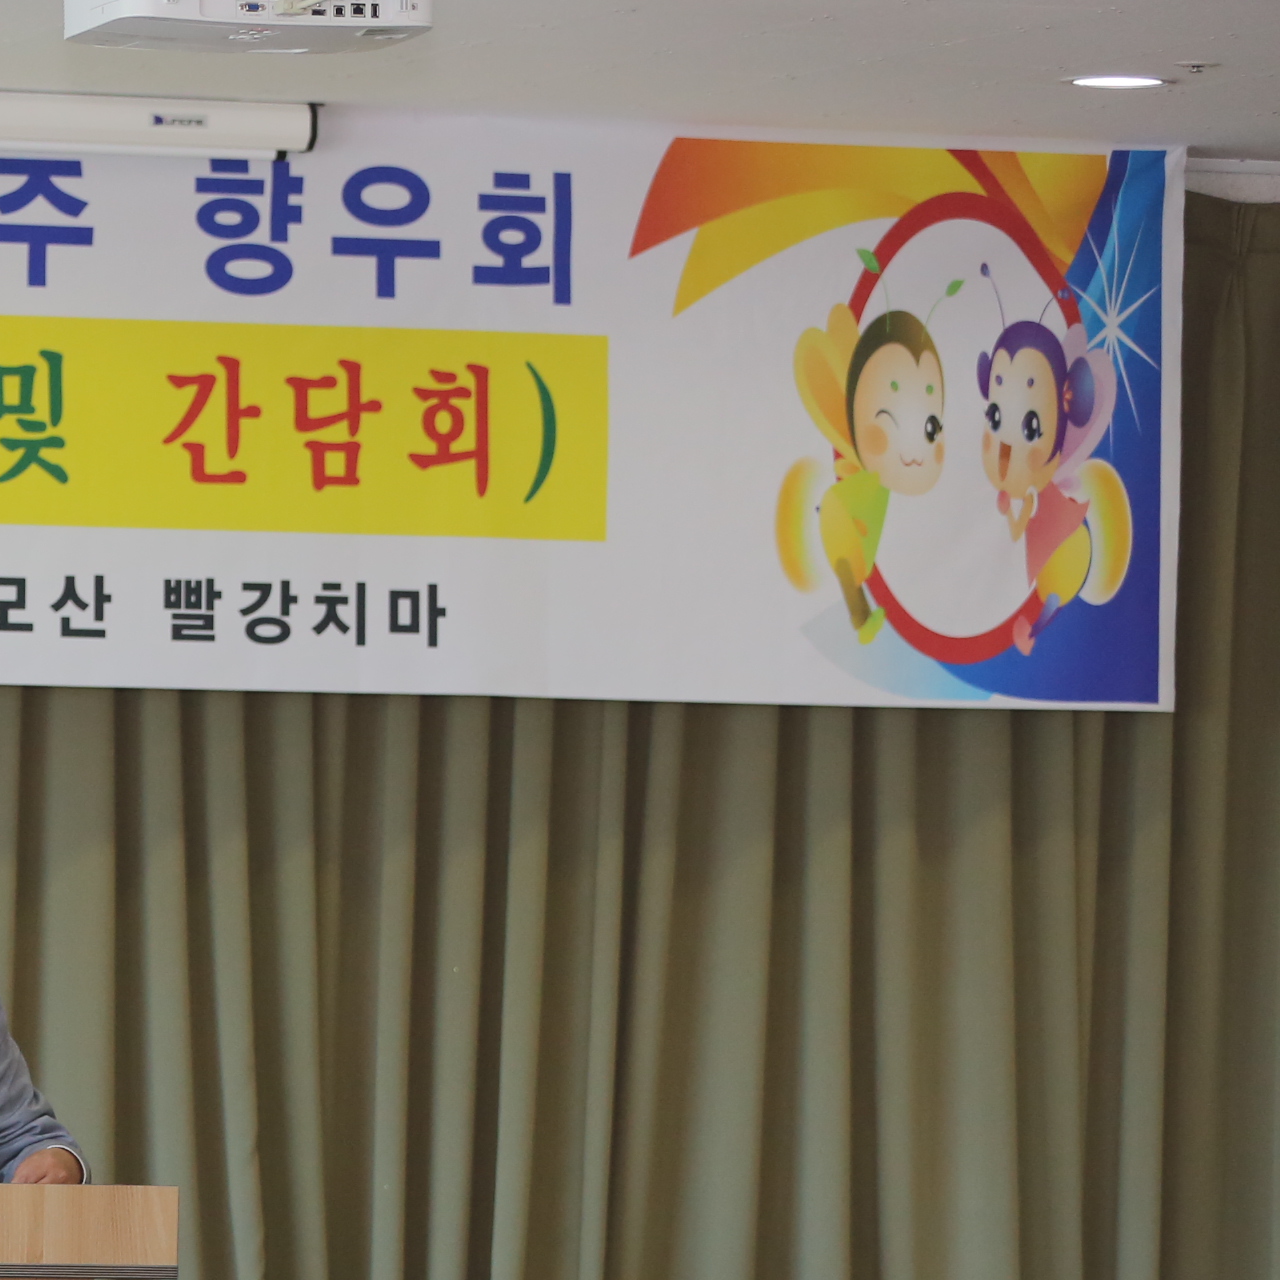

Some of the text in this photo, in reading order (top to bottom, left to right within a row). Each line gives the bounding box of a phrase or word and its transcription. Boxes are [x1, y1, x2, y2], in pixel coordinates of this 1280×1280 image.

[195, 158, 573, 305] 향우회
[163, 355, 557, 505] 간담회)
[162, 577, 448, 649] 빨강치마
